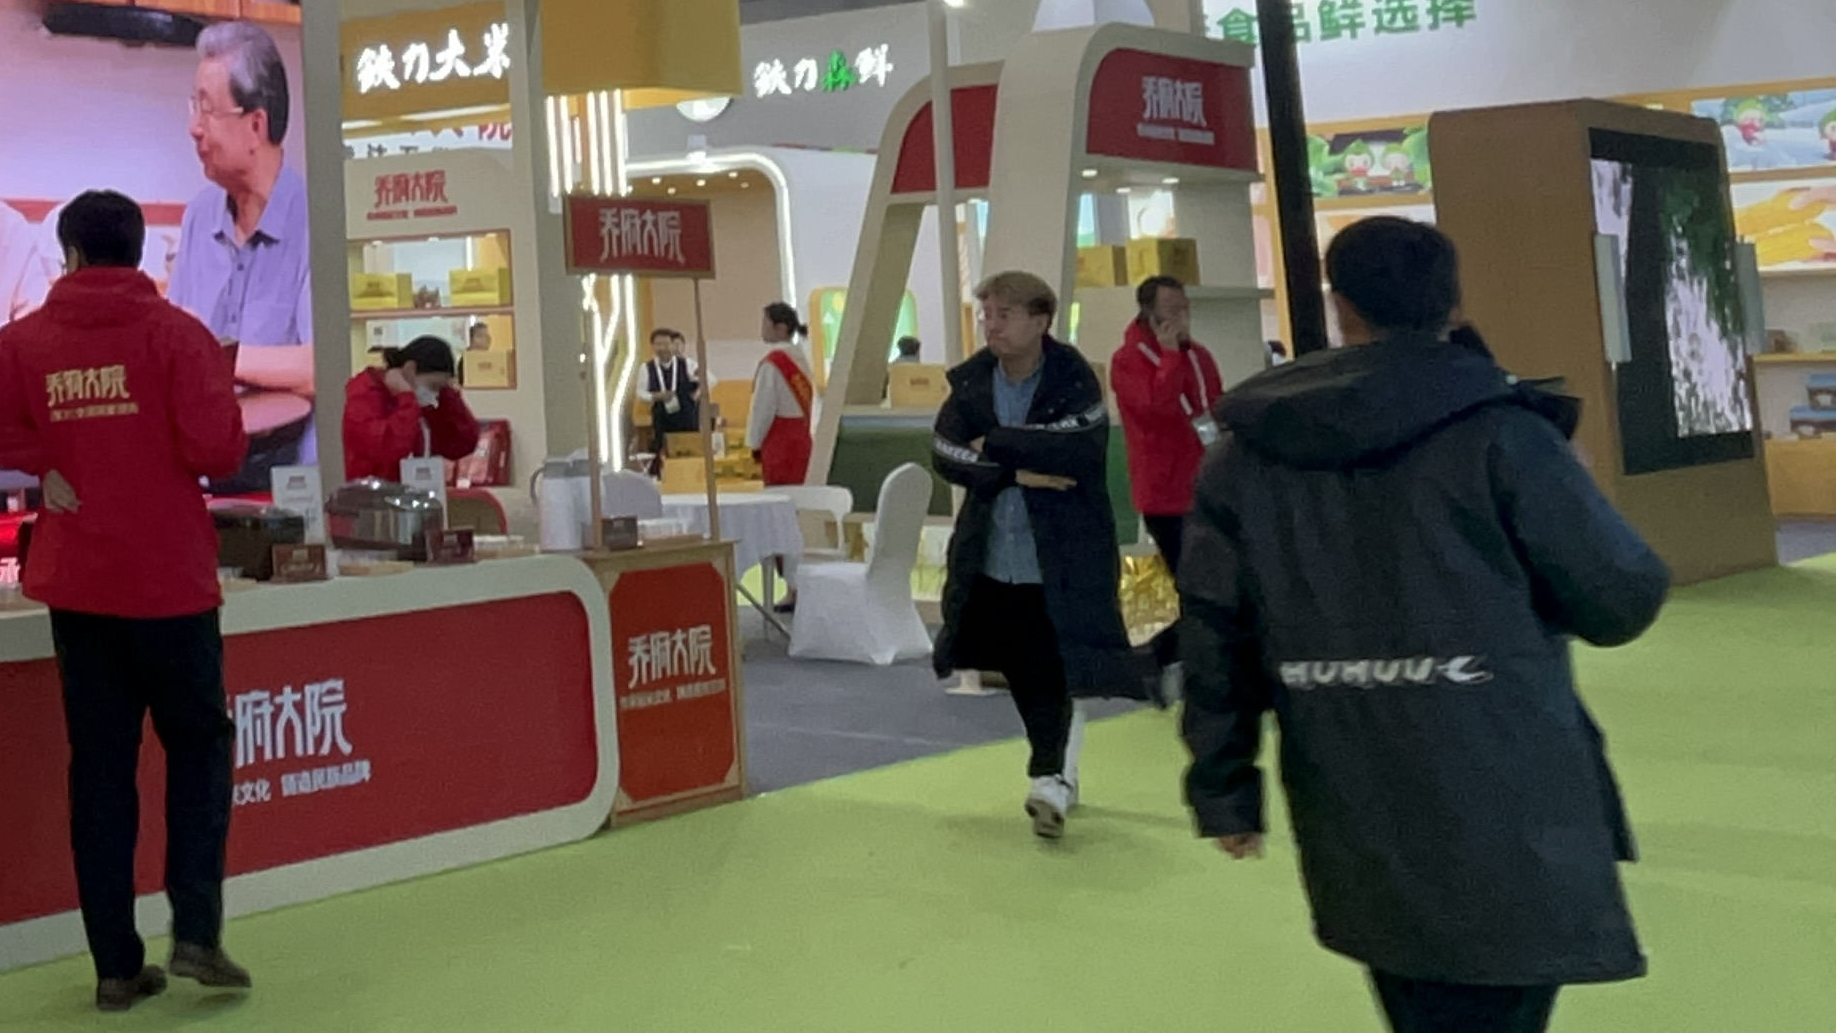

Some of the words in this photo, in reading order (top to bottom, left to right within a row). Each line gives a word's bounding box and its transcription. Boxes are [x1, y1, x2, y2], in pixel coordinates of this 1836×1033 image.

[599, 208, 686, 263] 乔府大院
[46, 364, 131, 407] 乔府大院
[628, 623, 716, 689] 乔府大院
[227, 678, 353, 769] 府大院
